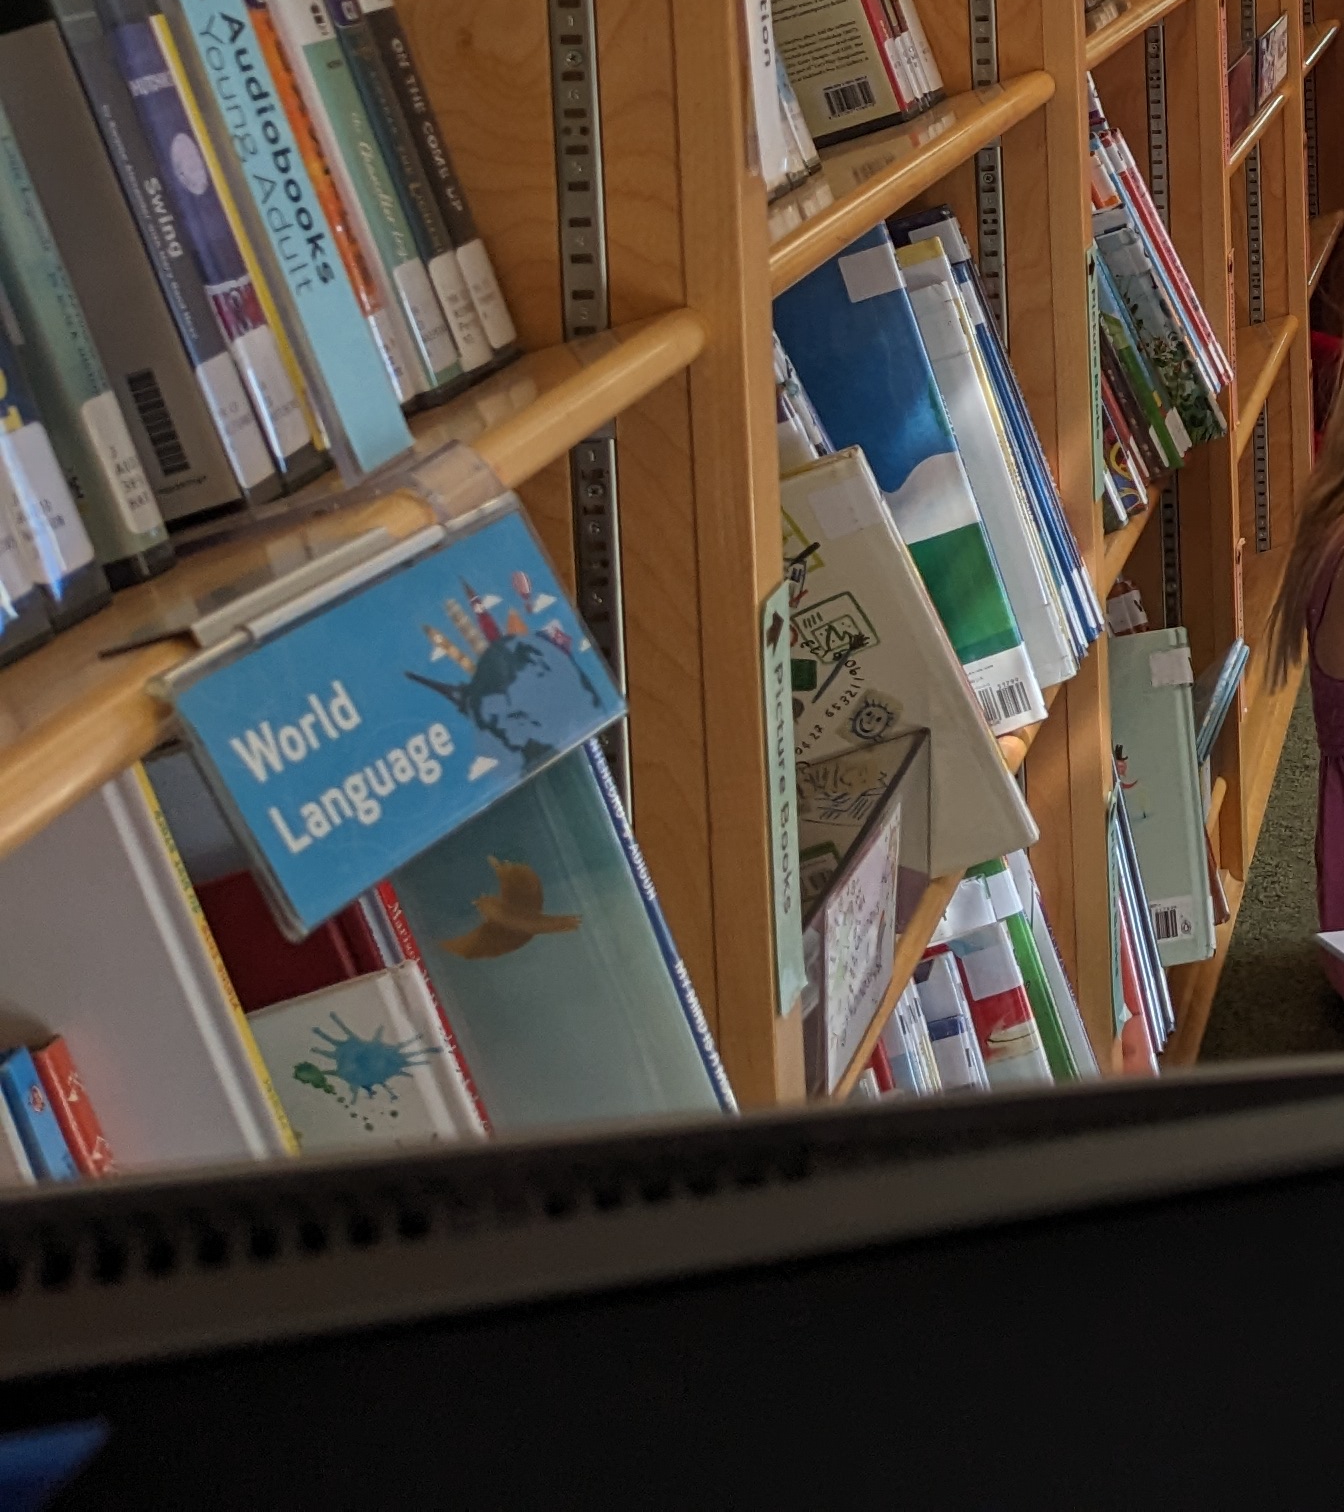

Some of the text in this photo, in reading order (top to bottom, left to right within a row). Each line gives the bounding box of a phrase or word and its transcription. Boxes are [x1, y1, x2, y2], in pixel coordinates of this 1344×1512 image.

[196, 12, 318, 295] Young Adult
[218, 10, 335, 287] Audiobooks
[388, 34, 466, 214] ON THE COME UP
[142, 174, 183, 260] Swing
[229, 679, 362, 784] World
[267, 722, 456, 854] Language
[773, 662, 794, 917] Picture Books
